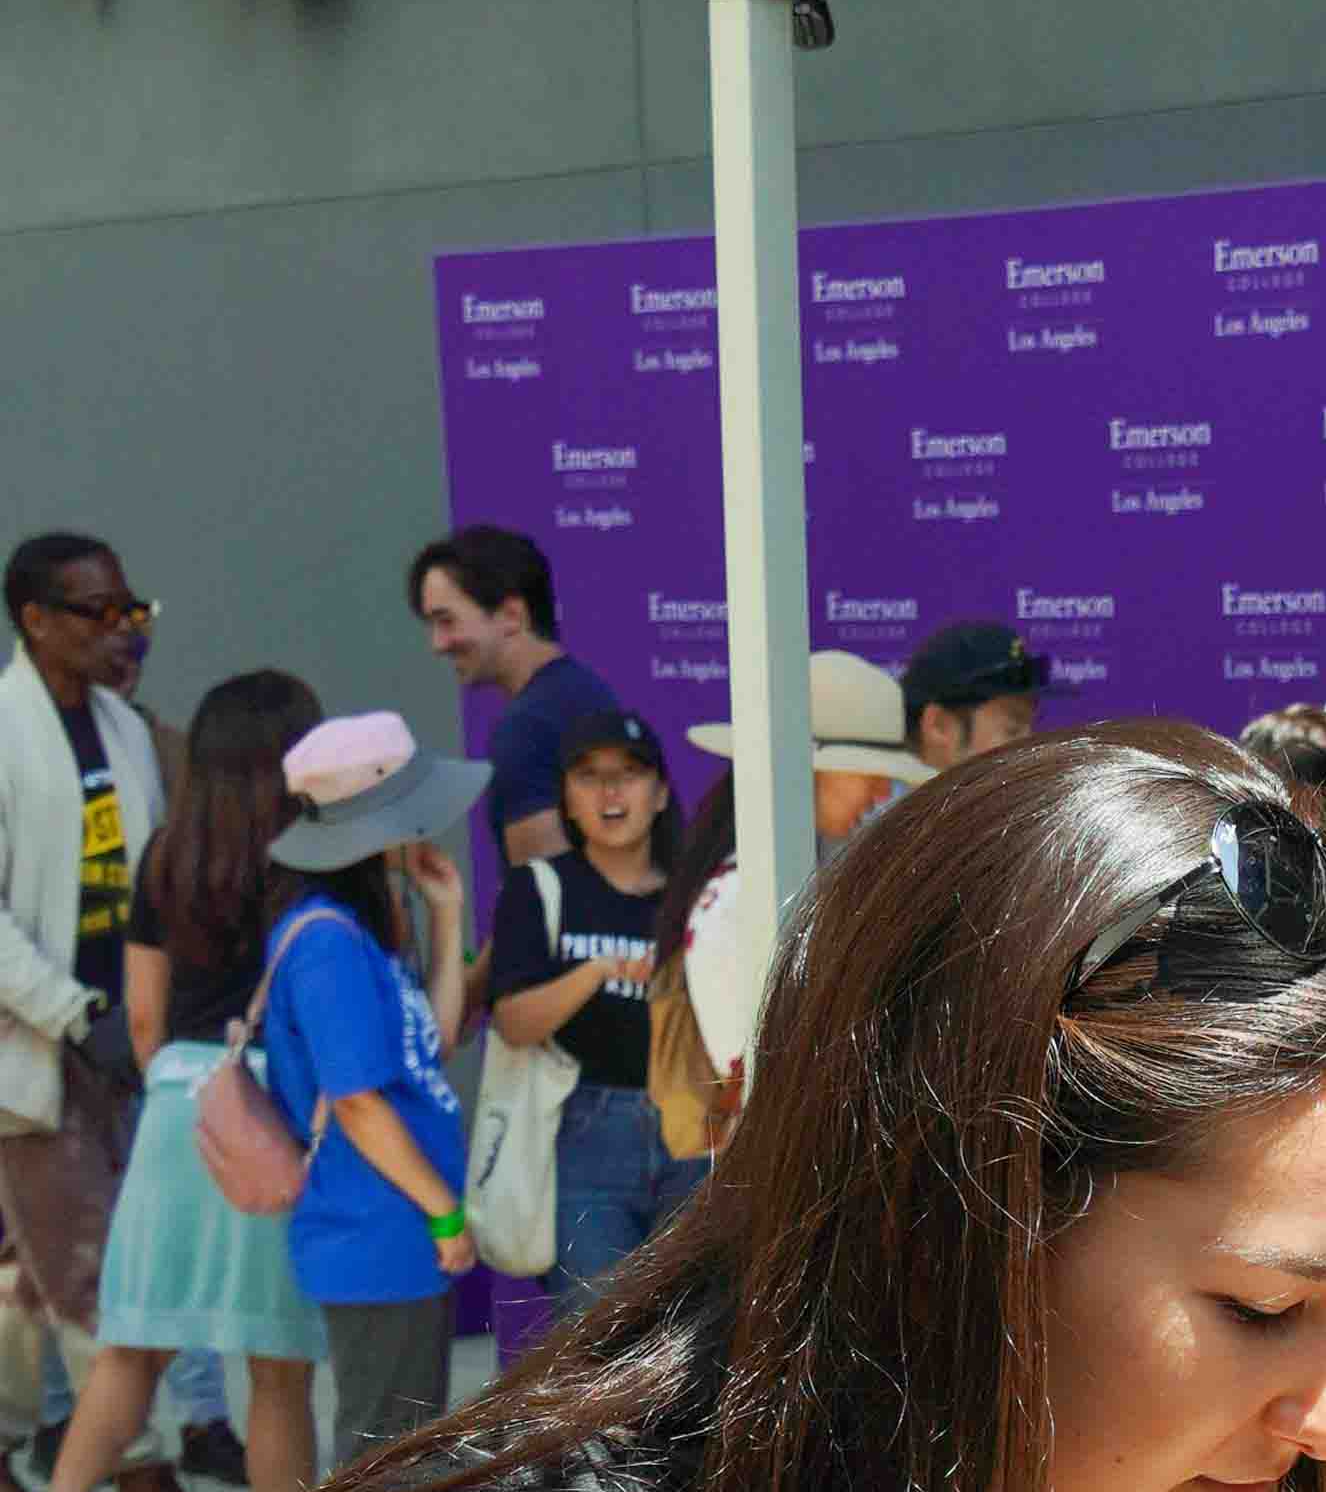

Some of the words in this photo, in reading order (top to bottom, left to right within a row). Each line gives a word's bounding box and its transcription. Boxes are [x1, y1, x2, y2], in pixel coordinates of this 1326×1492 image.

[1215, 239, 1319, 272] Emerson
[813, 273, 904, 302] Emerson
[1008, 258, 1104, 289] Emerson
[462, 295, 545, 323] Emerson
[632, 284, 718, 313] Emerson
[1215, 310, 1244, 336] Los
[1249, 308, 1310, 339] Angeles
[815, 341, 845, 362] Los
[1008, 328, 1036, 352] Los
[1041, 324, 1098, 356] Angeles
[634, 350, 664, 371] Los
[911, 429, 1007, 459] Emerson
[1110, 419, 1211, 450] Emerson
[553, 444, 638, 471] Emerson
[914, 499, 943, 520] Los
[947, 496, 1000, 524] Angeles
[1112, 490, 1142, 514] Los
[1147, 487, 1203, 518] Angeles
[827, 591, 918, 620] Emerson
[1017, 589, 1115, 620] Emerson
[1222, 583, 1326, 616] Emerson
[1224, 656, 1255, 679] Los
[1259, 654, 1319, 684] Angeles
